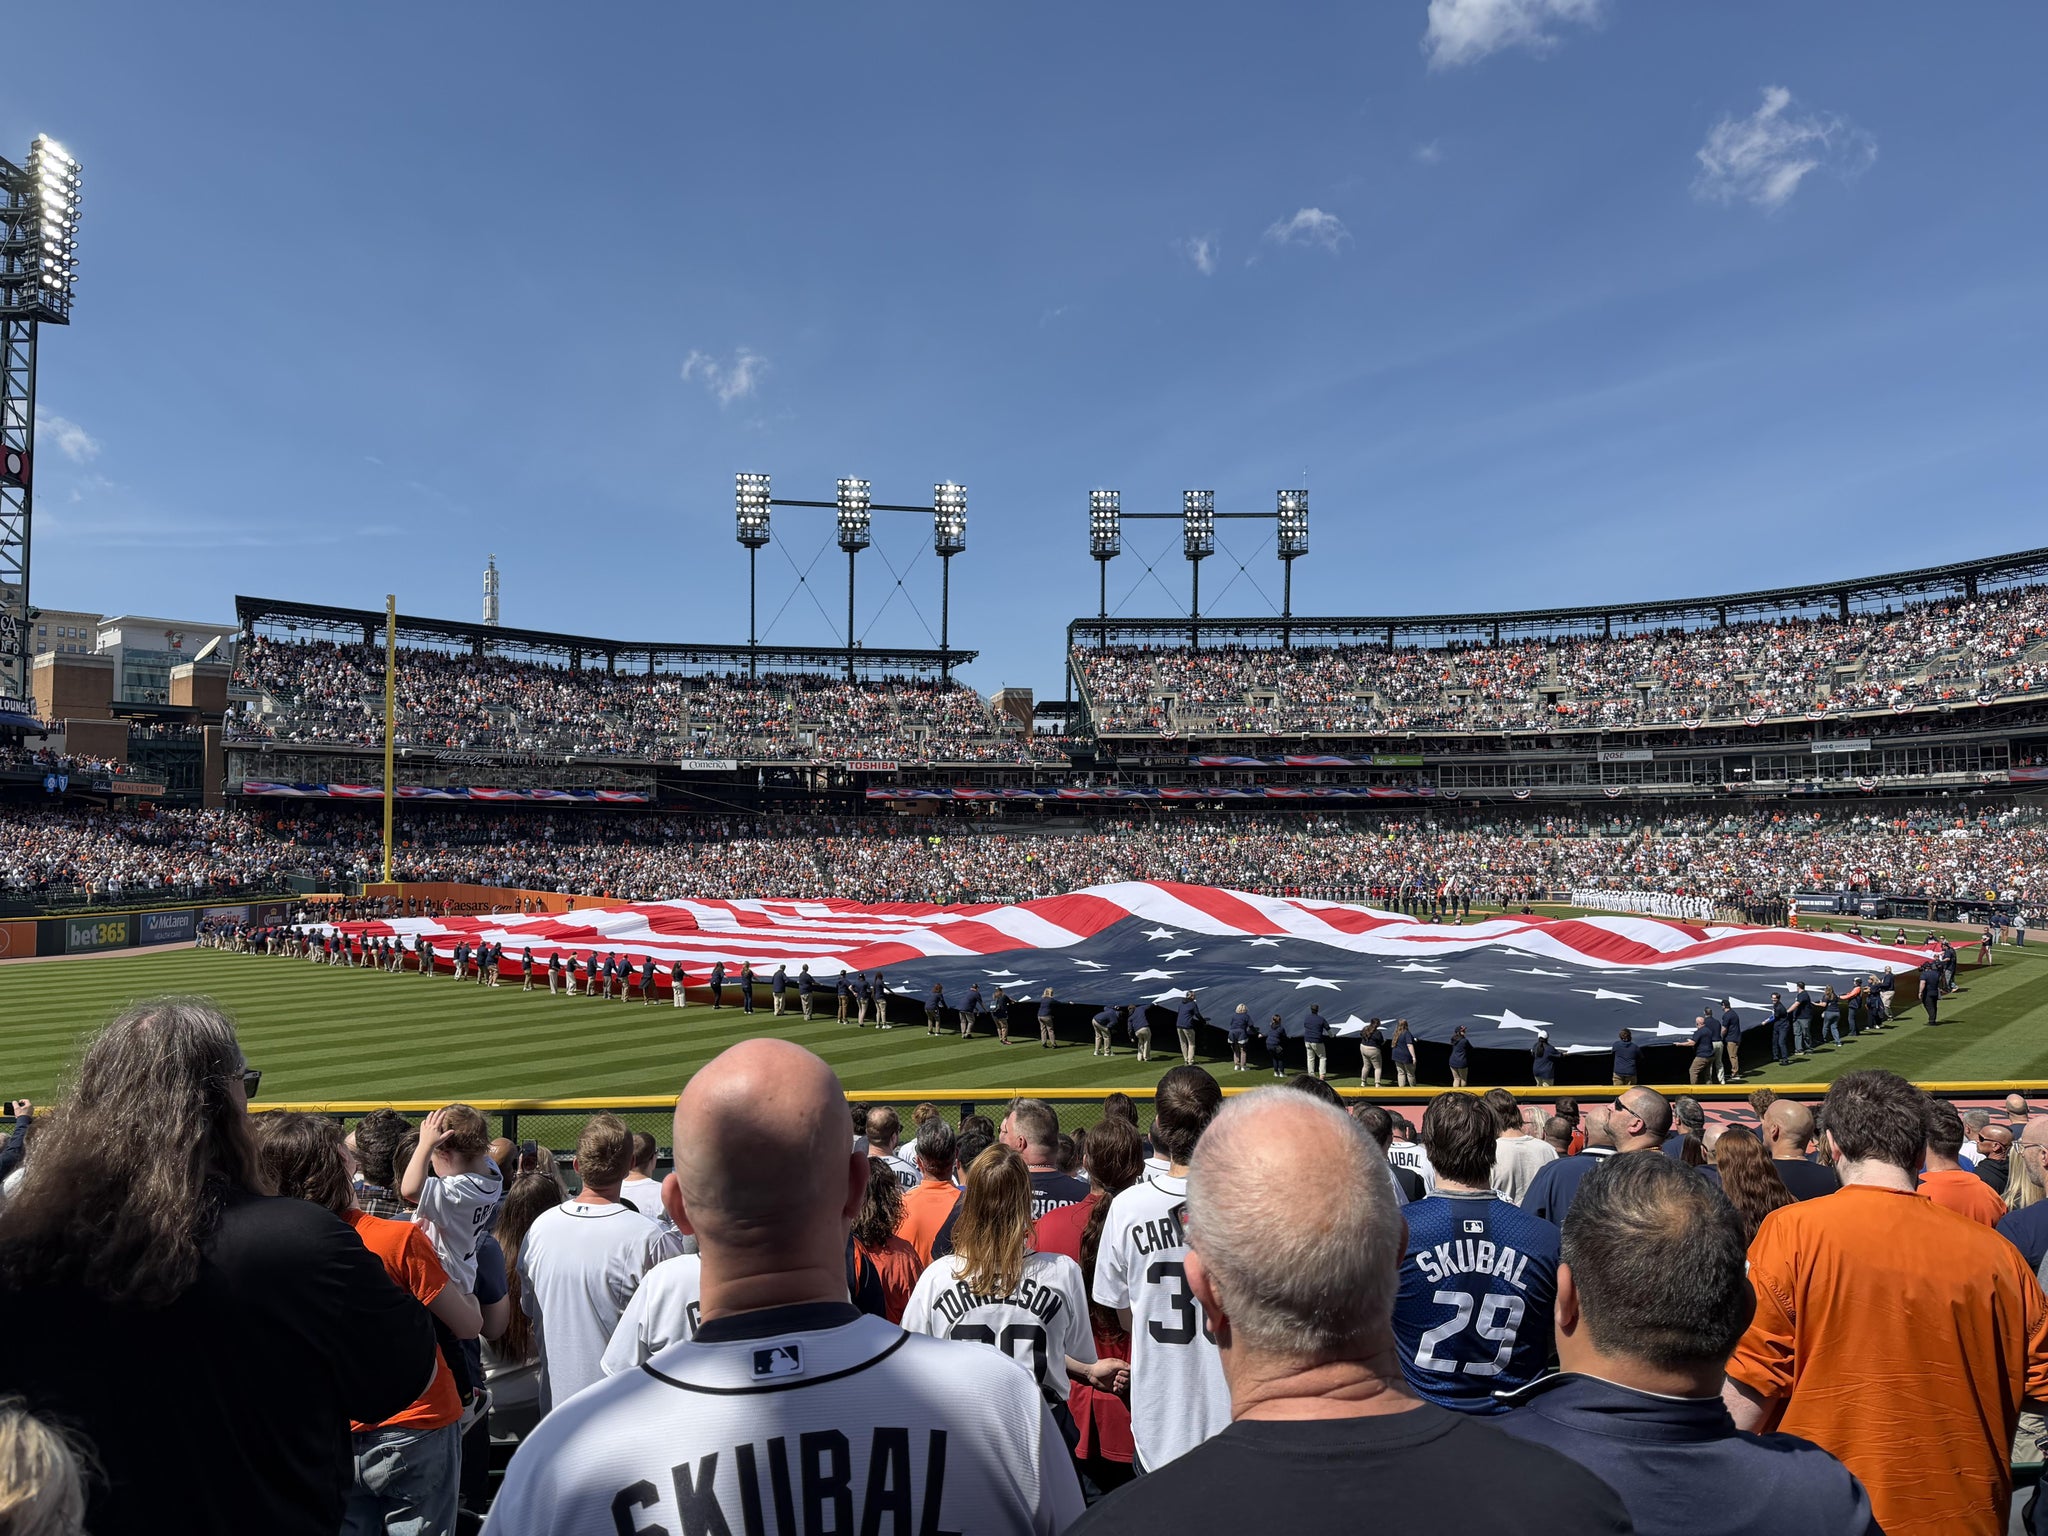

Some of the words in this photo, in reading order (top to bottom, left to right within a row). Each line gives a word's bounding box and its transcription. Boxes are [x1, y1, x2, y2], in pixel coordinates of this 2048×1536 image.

[848, 761, 896, 770] TOSHIBA
[71, 922, 126, 947] bet365
[158, 915, 189, 929] McLaren
[1416, 1239, 1529, 1291] SKUBAL
[1414, 1290, 1526, 1376] 29
